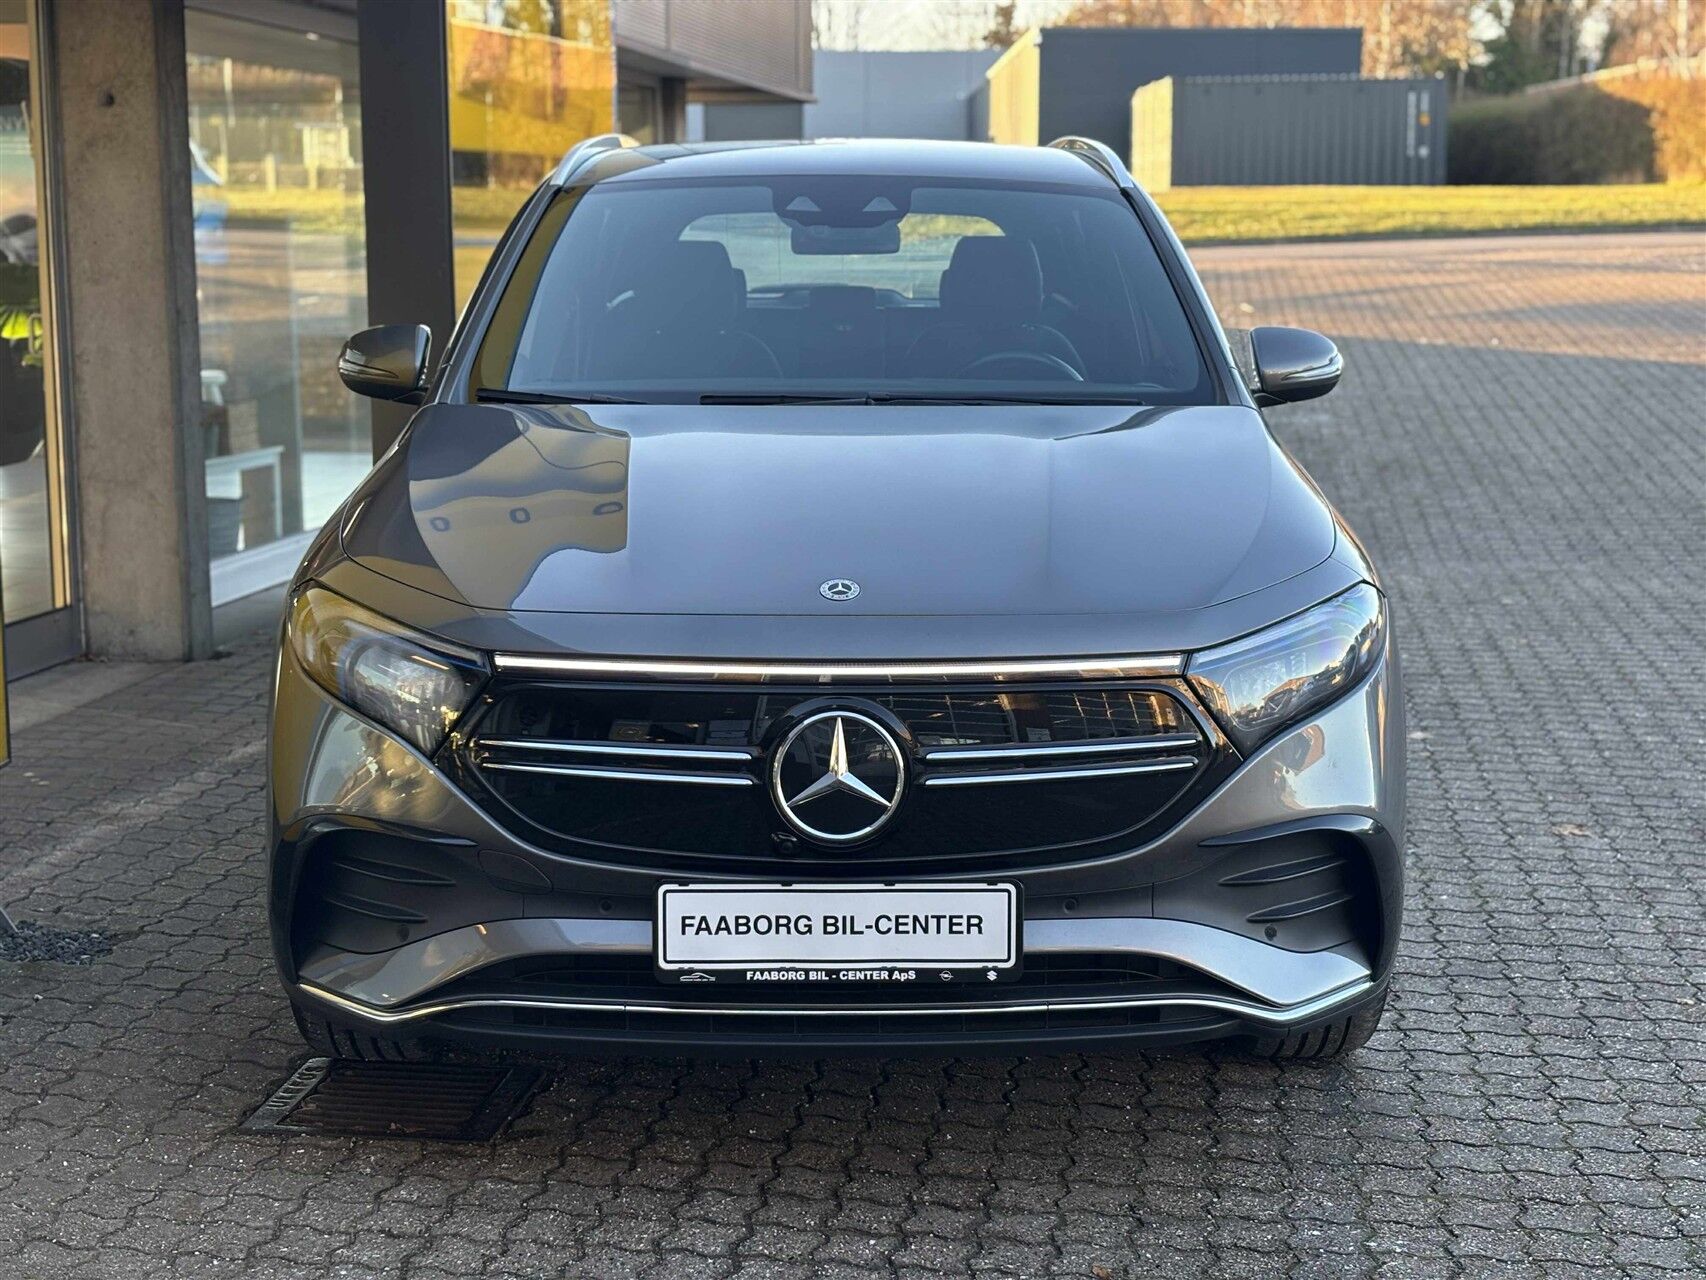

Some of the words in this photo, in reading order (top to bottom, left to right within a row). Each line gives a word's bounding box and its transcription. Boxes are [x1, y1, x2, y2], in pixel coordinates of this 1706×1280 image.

[681, 914, 813, 936] FAABORG
[822, 914, 984, 936] BIL-CENTER
[746, 970, 806, 981] FAABORG
[808, 970, 829, 980] BIL
[839, 970, 889, 980] CENTER
[891, 970, 917, 982] ApS
